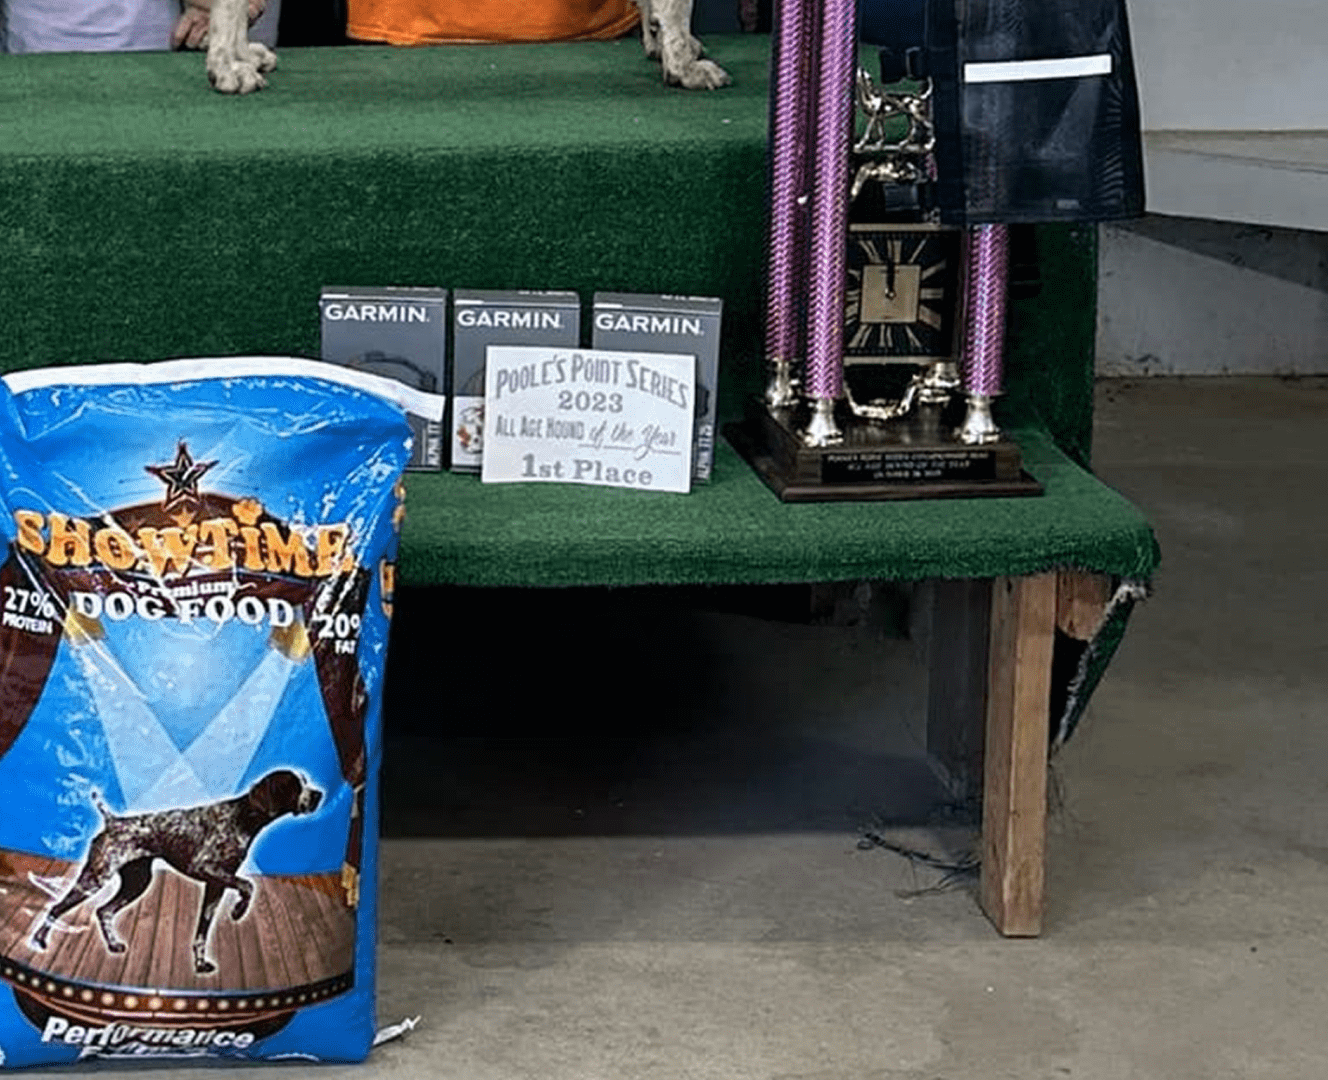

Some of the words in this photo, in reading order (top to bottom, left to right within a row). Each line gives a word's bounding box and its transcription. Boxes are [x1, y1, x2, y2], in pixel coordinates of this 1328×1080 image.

[325, 303, 429, 323] GARMIN
[457, 309, 563, 329] GARMIN
[595, 312, 704, 336] GARMIN
[496, 353, 567, 400] POOLE'S
[571, 353, 622, 385] POINT
[626, 359, 689, 410] SERIES
[558, 389, 623, 413] 2023
[495, 414, 517, 438] ALL
[519, 415, 543, 439] AGE
[546, 416, 585, 441] HOUND
[588, 420, 608, 450] of
[610, 421, 635, 442] the
[633, 423, 677, 462] Year
[522, 452, 565, 479] 1st
[572, 458, 654, 486] Place
[4, 586, 55, 618] 27%
[75, 591, 166, 621] DOG
[180, 594, 296, 628] FOOD
[2, 612, 53, 635] PROTEIN
[334, 640, 356, 654] FAT
[41, 1016, 256, 1049] Performance
